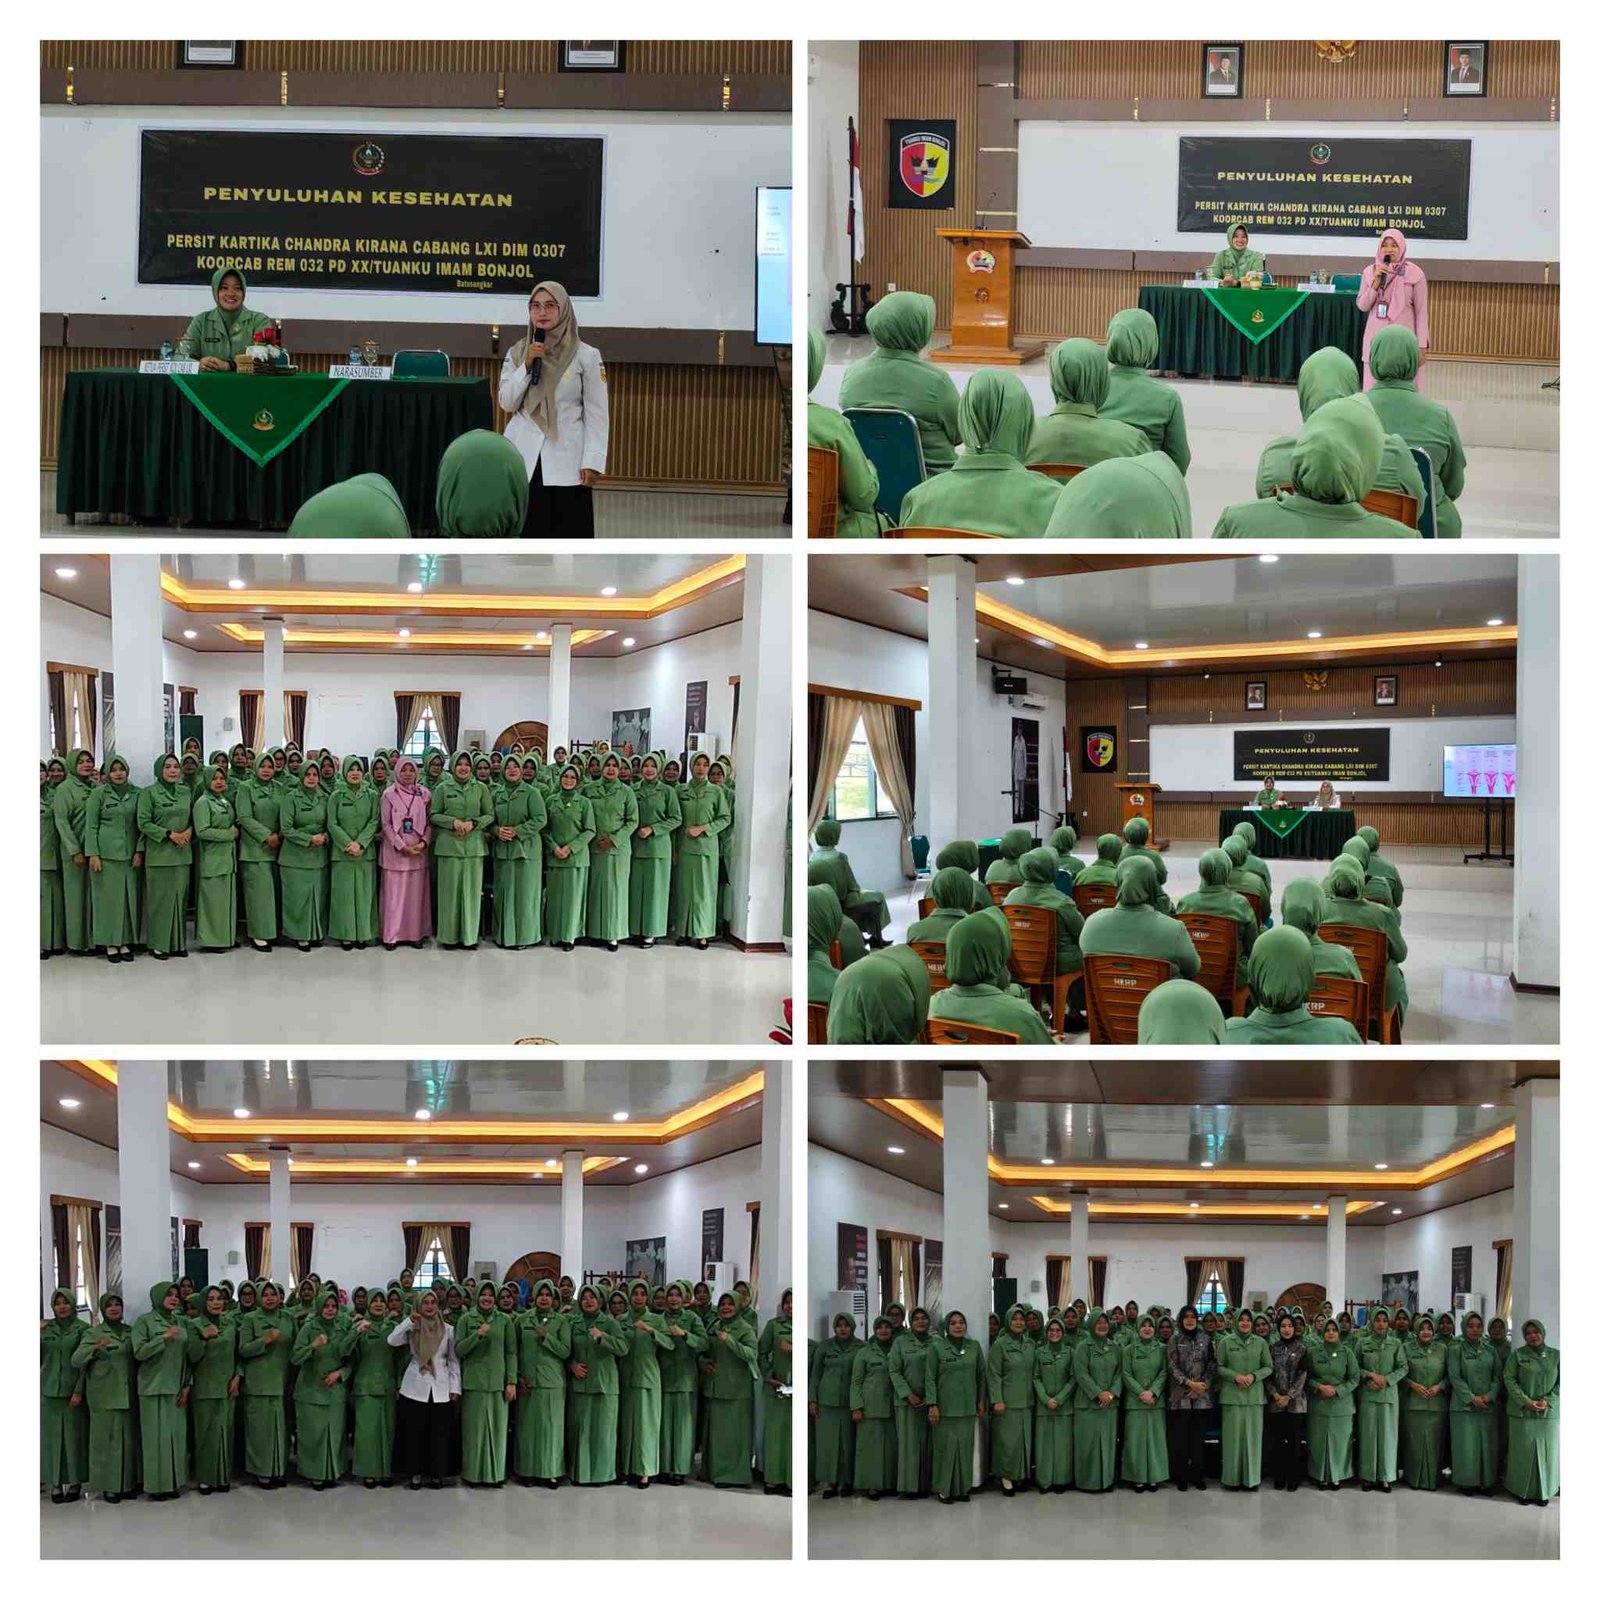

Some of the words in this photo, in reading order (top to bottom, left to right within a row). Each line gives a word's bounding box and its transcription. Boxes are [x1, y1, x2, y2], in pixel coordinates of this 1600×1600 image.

[1217, 171, 1317, 182] PENYULUHAN
[1322, 173, 1413, 184] KESEHATAN
[203, 187, 362, 204] PENYULUHAN
[372, 191, 513, 207] KESEHATAN
[1194, 201, 1225, 210] PERSIT
[1227, 202, 1265, 211] KARTIKA
[1267, 203, 1309, 212] CHANDRA
[1311, 204, 1345, 213] KIRANA
[1348, 205, 1385, 214] CABANG
[1388, 206, 1402, 215] LXI
[1405, 206, 1422, 215] DIM
[1425, 207, 1447, 216] 0307
[1213, 214, 1254, 224] KOORCAB
[1256, 215, 1275, 225] REM
[1276, 216, 1292, 225] 032
[1294, 216, 1306, 225] PD
[1308, 217, 1360, 227] XX/TUANKU
[1362, 218, 1387, 228] IMAM
[1389, 219, 1426, 229] BONJOL
[167, 234, 215, 249] PERSIT
[220, 236, 280, 251] KARTIKA
[285, 237, 351, 252] CHANDRA
[355, 239, 408, 254] KIRANA
[413, 240, 470, 256] CABANG
[475, 242, 497, 256] LXI
[502, 243, 528, 257] DIM
[533, 244, 566, 258] 0307
[197, 255, 262, 270] KOORCAB
[267, 257, 295, 271] REM
[300, 258, 323, 272] 032
[328, 259, 346, 273] PD
[351, 259, 431, 275] XX/TUANKU
[436, 262, 472, 276] IMAM
[477, 263, 534, 278] BONJOL
[456, 279, 493, 290] Batusangkar
[333, 366, 384, 378] NARASUMBER
